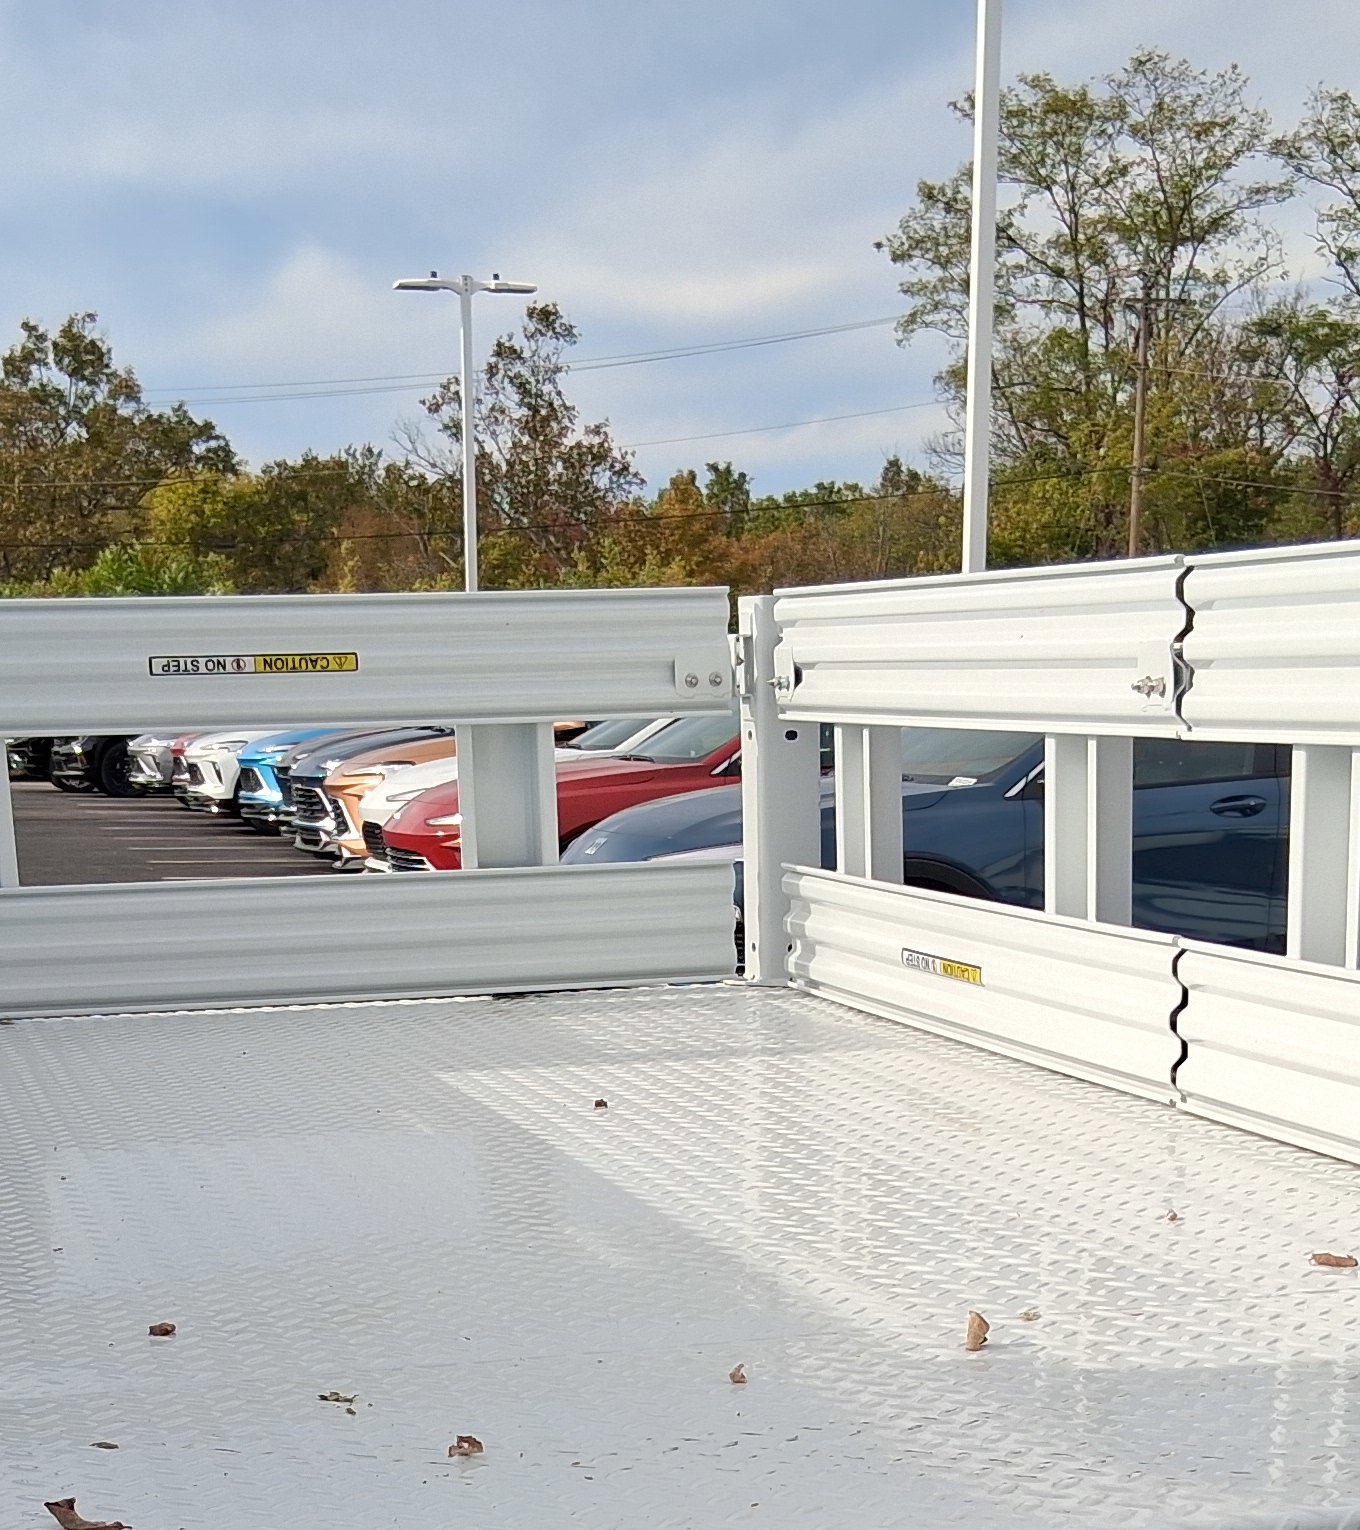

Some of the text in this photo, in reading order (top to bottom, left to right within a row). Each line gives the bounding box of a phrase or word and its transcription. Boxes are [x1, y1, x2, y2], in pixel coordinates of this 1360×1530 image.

[161, 656, 330, 673] CAUTION NO STEP
